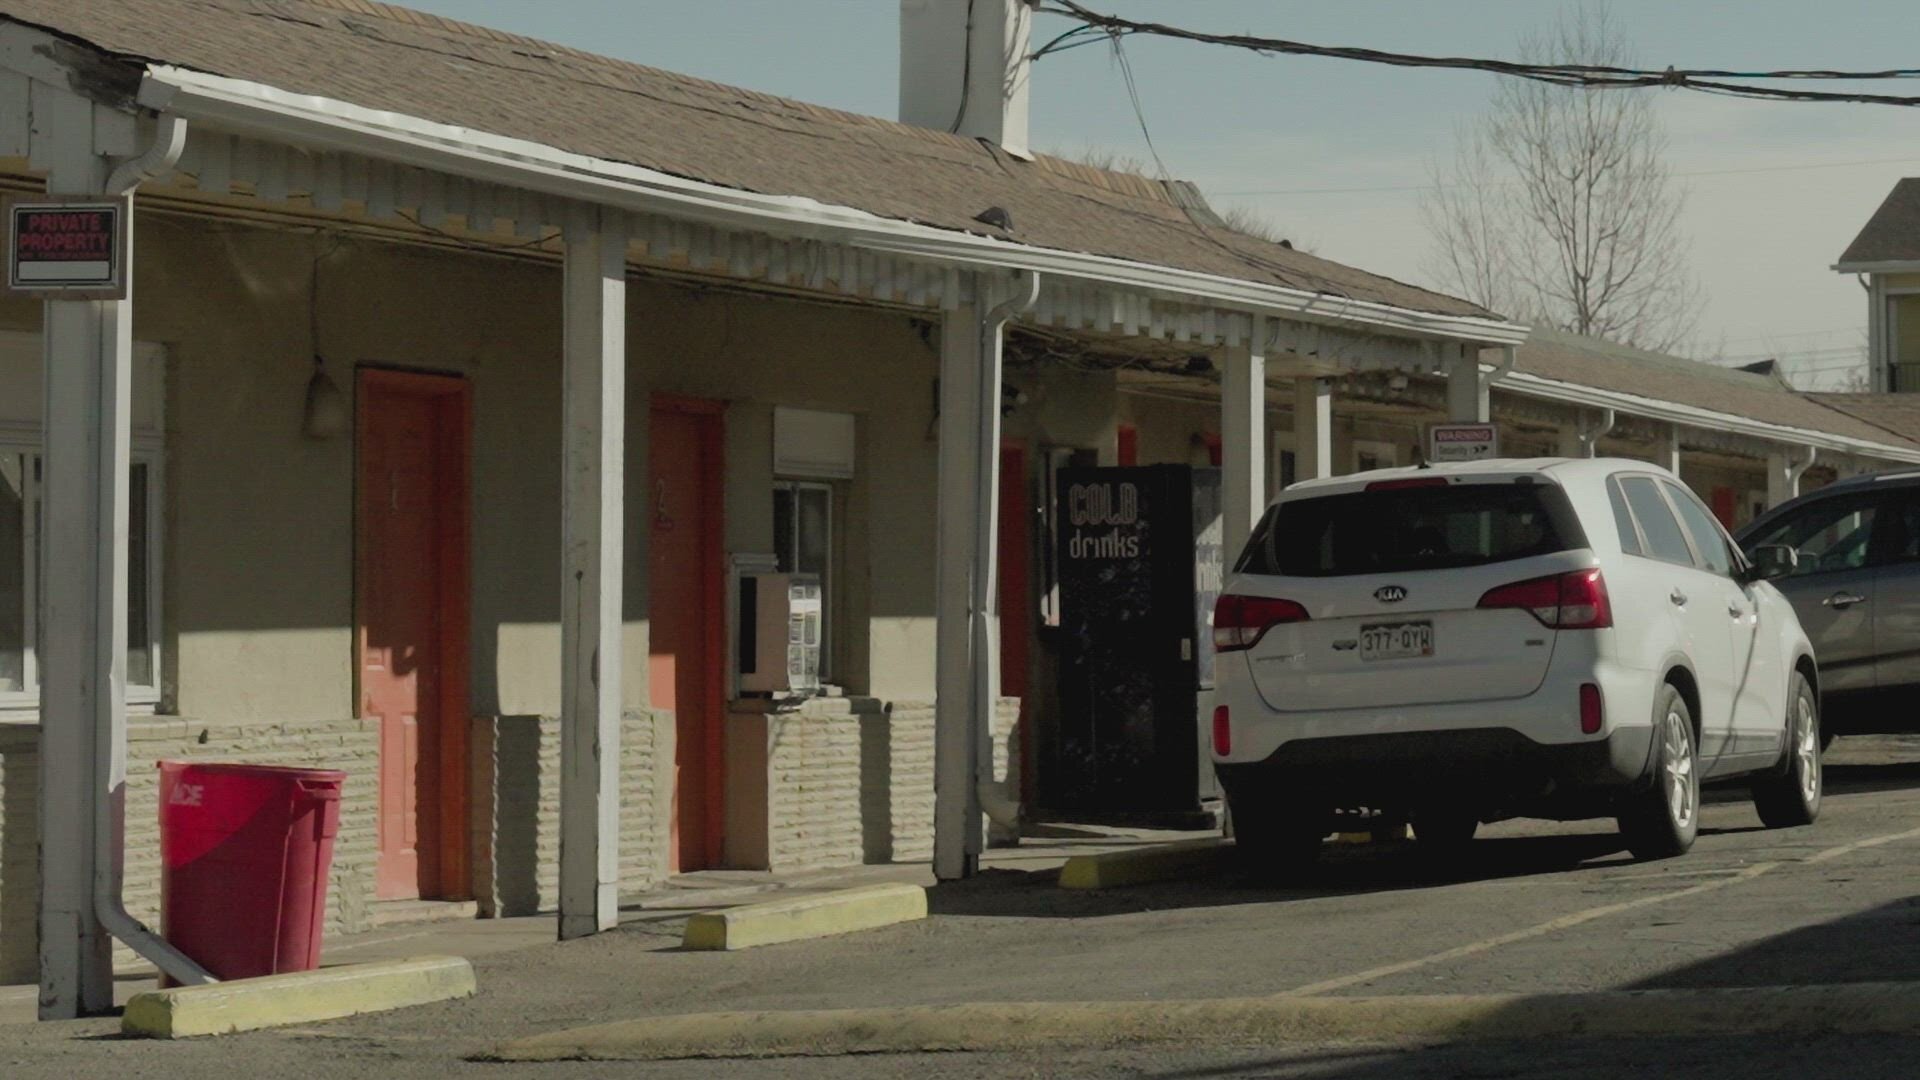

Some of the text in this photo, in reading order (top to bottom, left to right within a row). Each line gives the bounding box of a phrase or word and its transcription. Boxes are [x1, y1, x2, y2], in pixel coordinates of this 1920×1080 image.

[29, 213, 101, 231] PRIVATE
[18, 233, 109, 250] PROPERTY
[1437, 430, 1489, 441] WARNING
[1069, 482, 1138, 526] COLD
[1069, 527, 1139, 558] drinks
[1379, 587, 1404, 600] KIA
